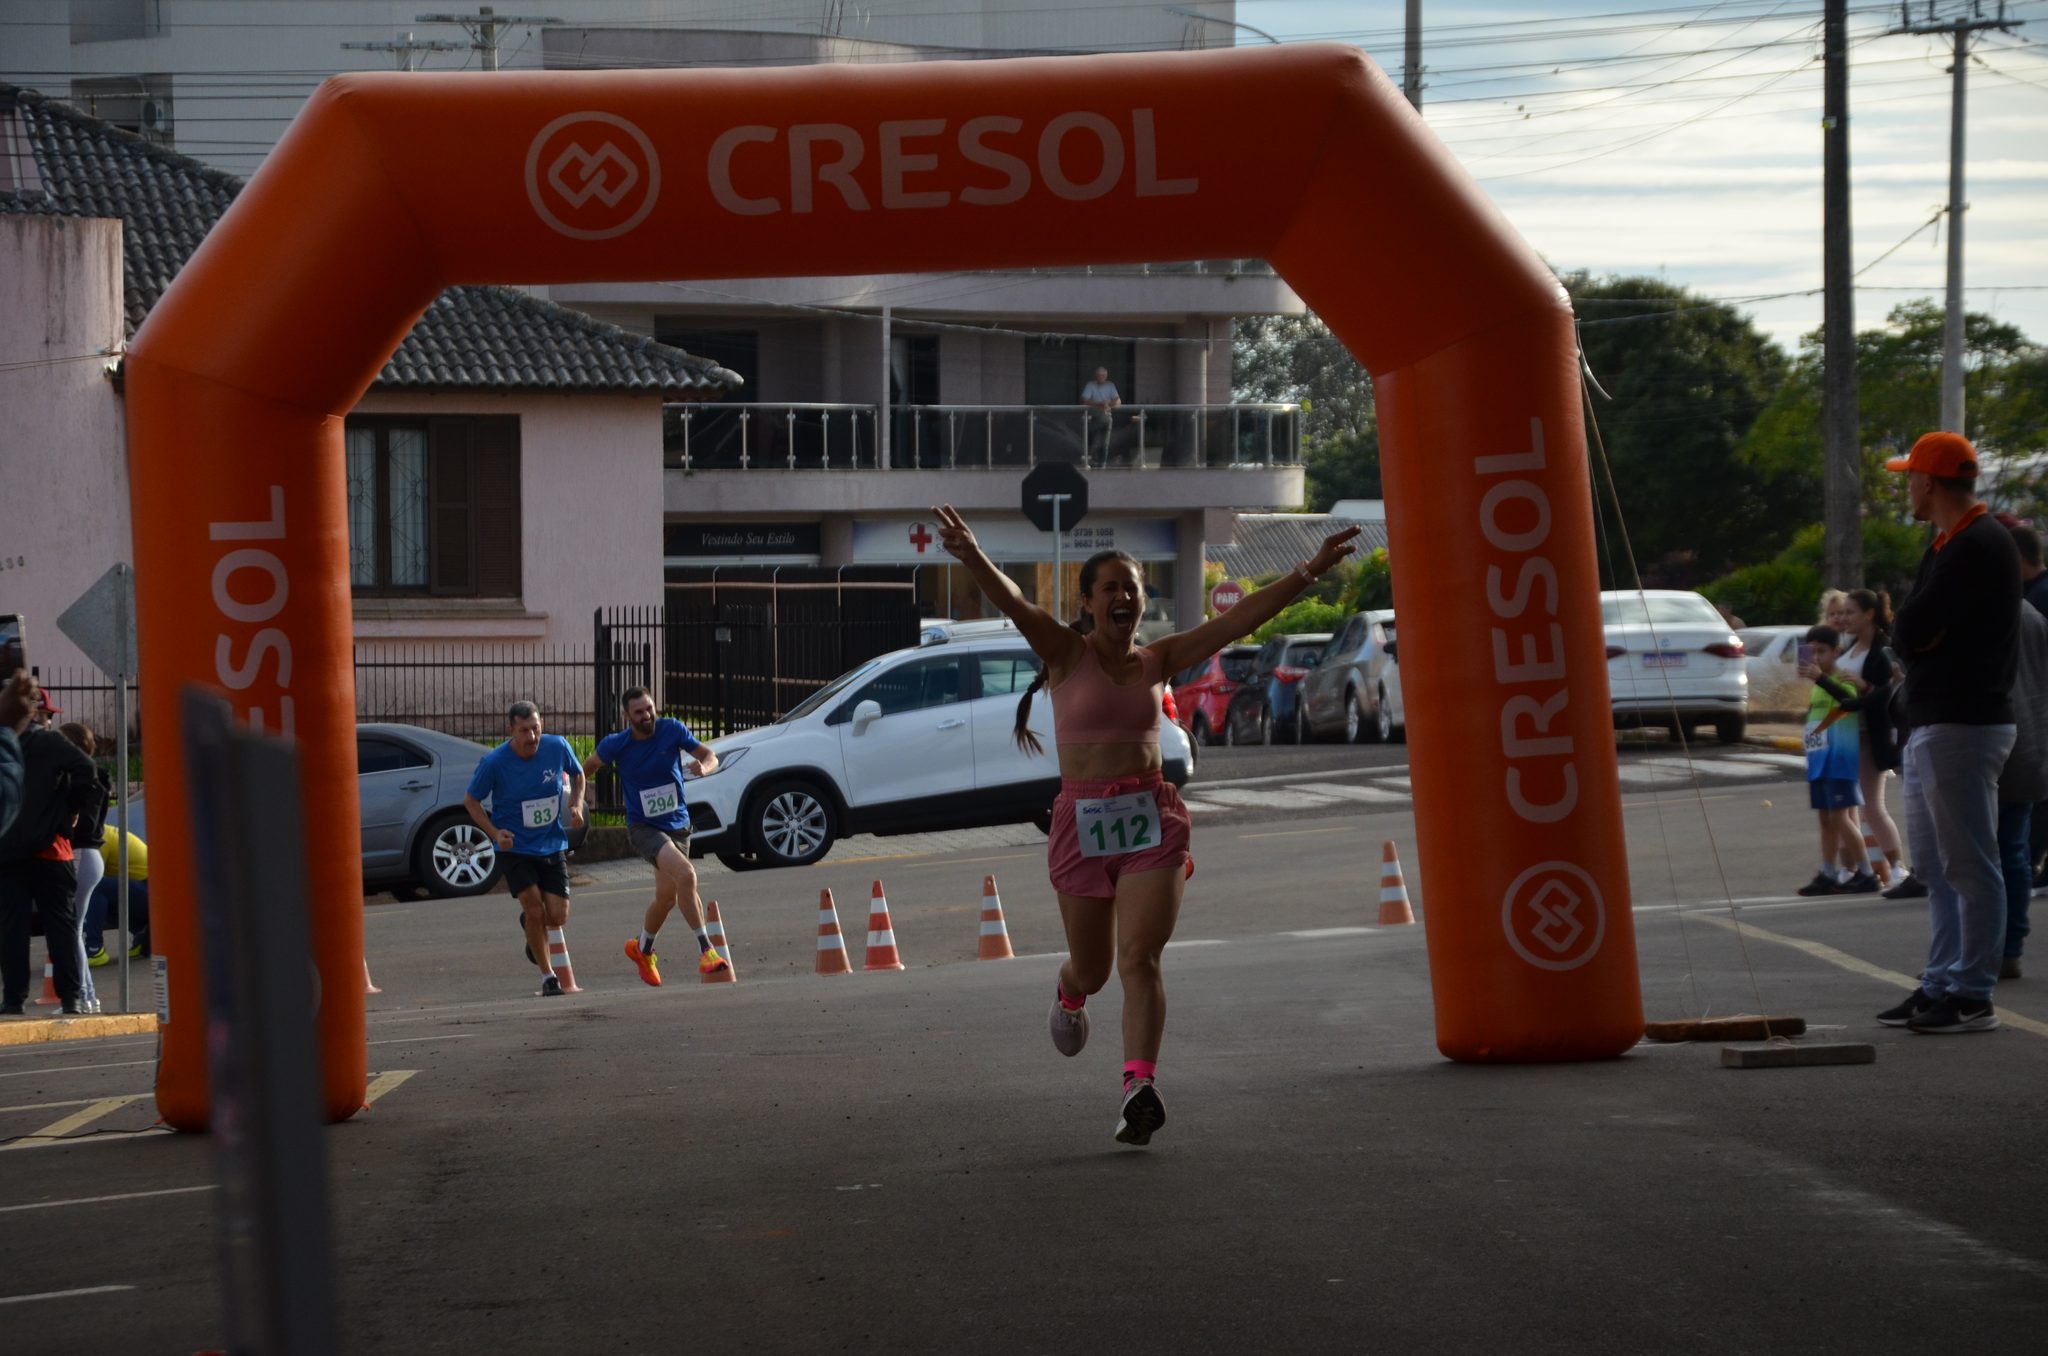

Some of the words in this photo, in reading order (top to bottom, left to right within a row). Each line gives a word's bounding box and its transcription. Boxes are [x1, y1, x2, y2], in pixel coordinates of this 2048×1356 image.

[706, 107, 1199, 217] CRESOL
[701, 532, 743, 545] Vestindo
[745, 532, 764, 545] Seu
[766, 532, 796, 545] Estilo
[1216, 592, 1240, 604] PARE
[1474, 416, 1580, 824] CRESOL
[647, 793, 675, 814] 294
[533, 808, 551, 825] 83
[1089, 814, 1152, 851] 112
